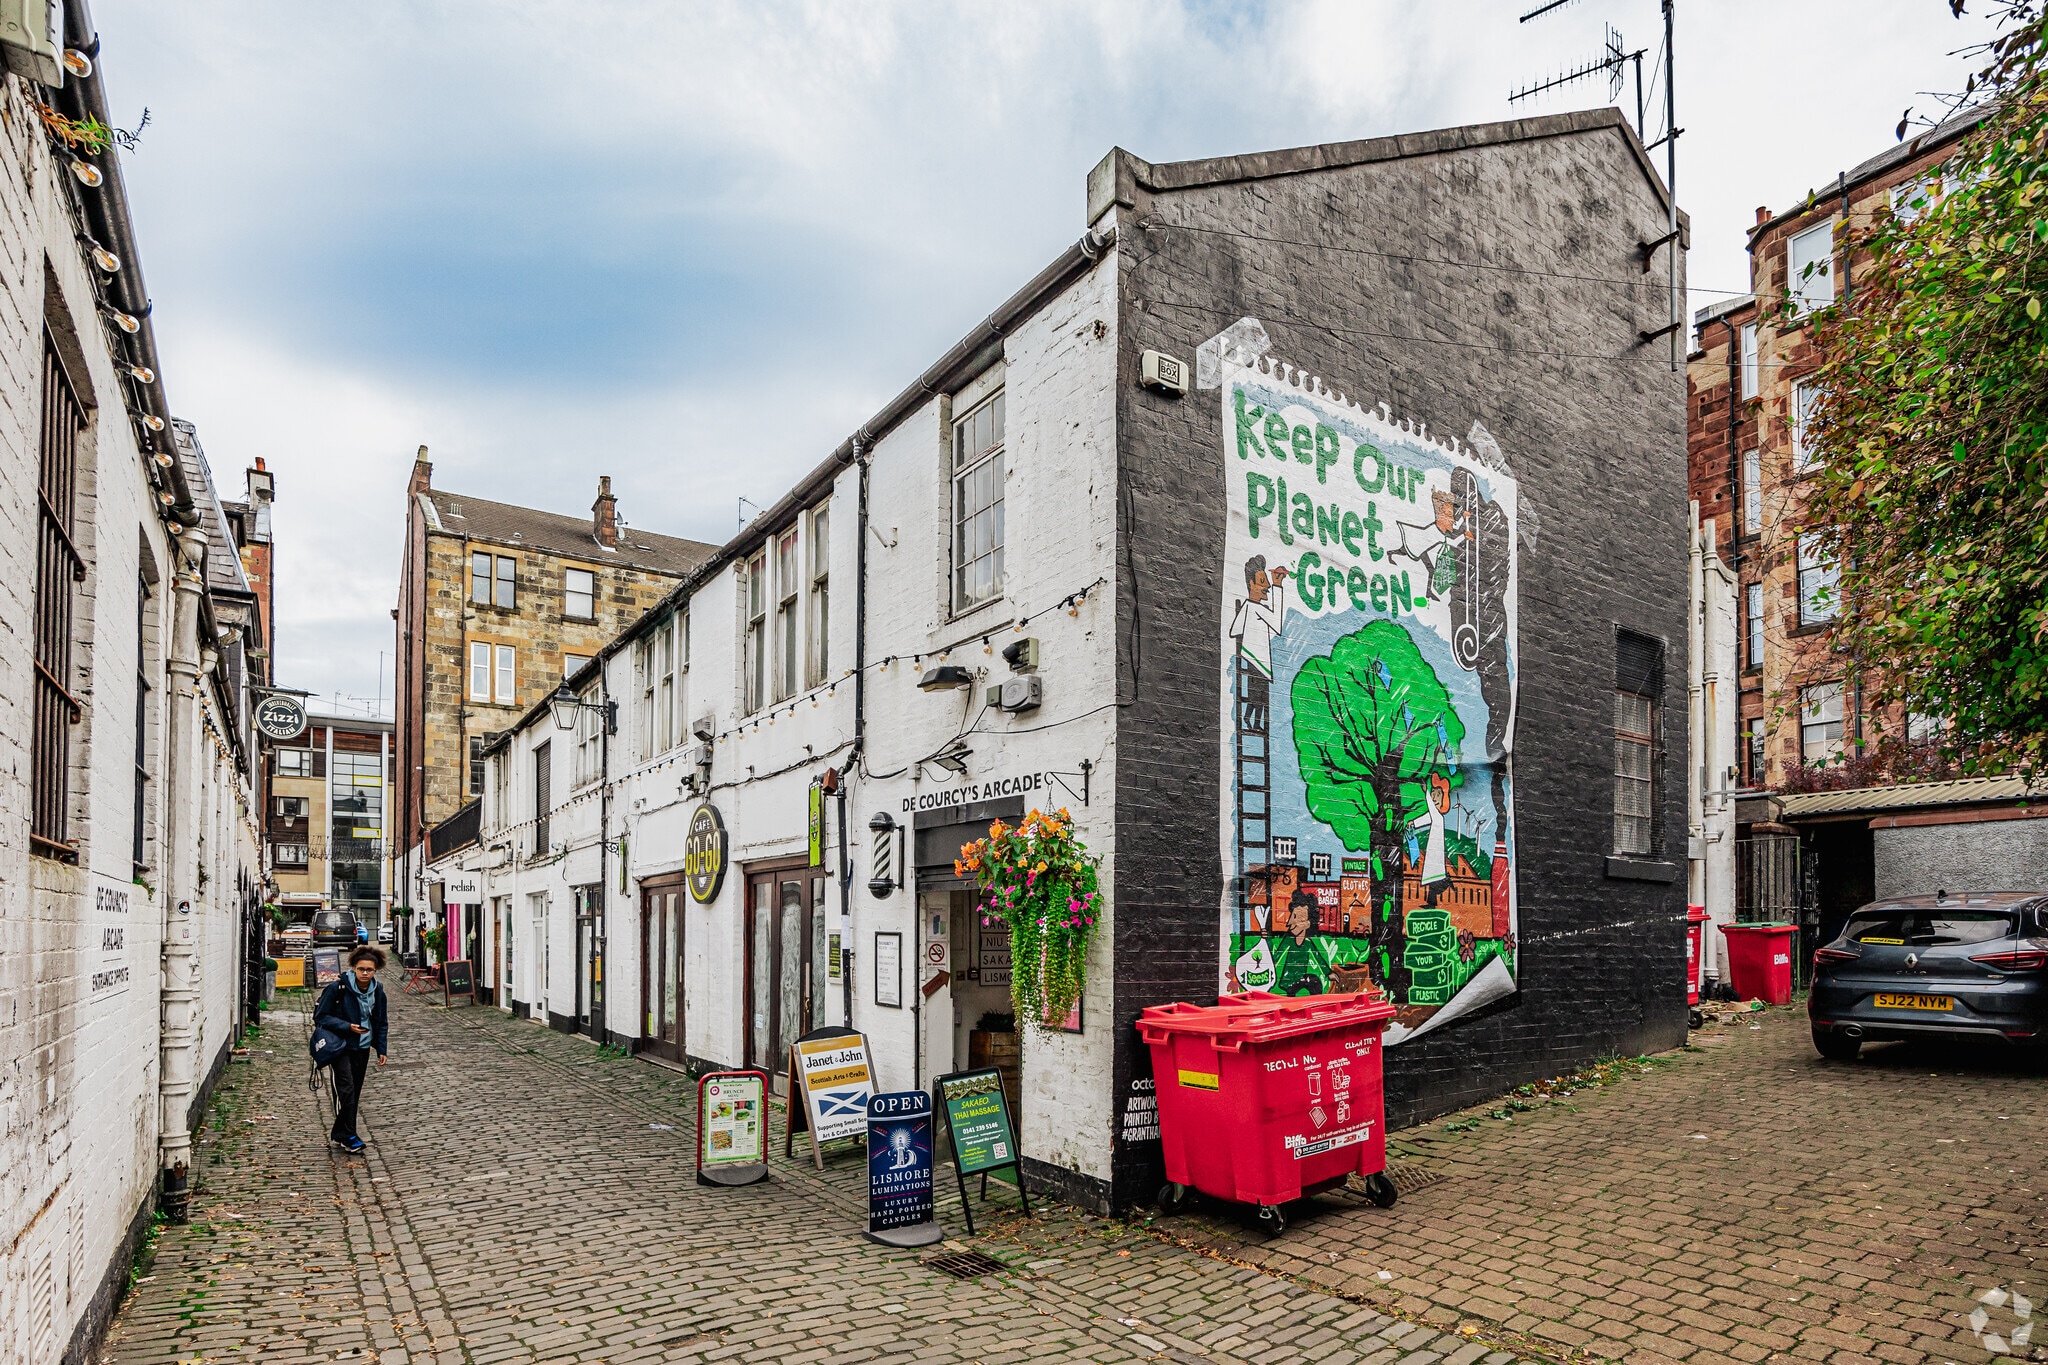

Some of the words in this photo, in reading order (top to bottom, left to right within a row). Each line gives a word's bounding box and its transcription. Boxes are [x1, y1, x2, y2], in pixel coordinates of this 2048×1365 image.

[1161, 366, 1177, 377] BOX
[1353, 444, 1425, 504] Our
[263, 710, 299, 724] Zizzi
[266, 725, 296, 736] ITALIAN
[903, 797, 915, 812] DE
[919, 785, 978, 809] COURCY'S
[983, 772, 1042, 799] ARCADE
[686, 831, 720, 876] GO-GO
[451, 880, 475, 892] relish
[1343, 880, 1369, 890] CLOTHES
[96, 886, 104, 910] DE
[1317, 888, 1339, 896] PLANT
[1318, 897, 1338, 905] BASED
[1412, 921, 1437, 934] RECYCLE
[102, 928, 123, 951] ARCADE
[986, 938, 1003, 947] NIU
[1415, 955, 1433, 965] YOUR
[1416, 990, 1439, 1001] PLASTIC
[1880, 995, 1915, 1006] SJ22
[1919, 997, 1947, 1008] NYM
[1356, 1047, 1370, 1056] ONLY
[806, 1054, 834, 1068] Janet
[839, 1050, 863, 1063] John
[811, 1075, 832, 1084] Scottish
[874, 1096, 924, 1113] OPEN
[961, 1097, 989, 1109] SAKAEO
[1127, 1096, 1158, 1111] ARTWOR
[954, 1112, 970, 1120] THAI
[970, 1105, 1000, 1117] MASSAGE
[1124, 1111, 1152, 1127] PAINTED
[1154, 1111, 1159, 1124] B
[817, 1122, 843, 1131] Supporting
[1122, 1125, 1161, 1142] #GRANTHA
[1284, 1134, 1307, 1149] Biffa
[872, 1169, 930, 1185] LISMORE
[872, 1181, 931, 1195] LUMINATIONS
[885, 1197, 919, 1207] LUXURY
[871, 1209, 894, 1218] HAND
[899, 1203, 932, 1214] POURED
[883, 1213, 920, 1224] CANDLES
